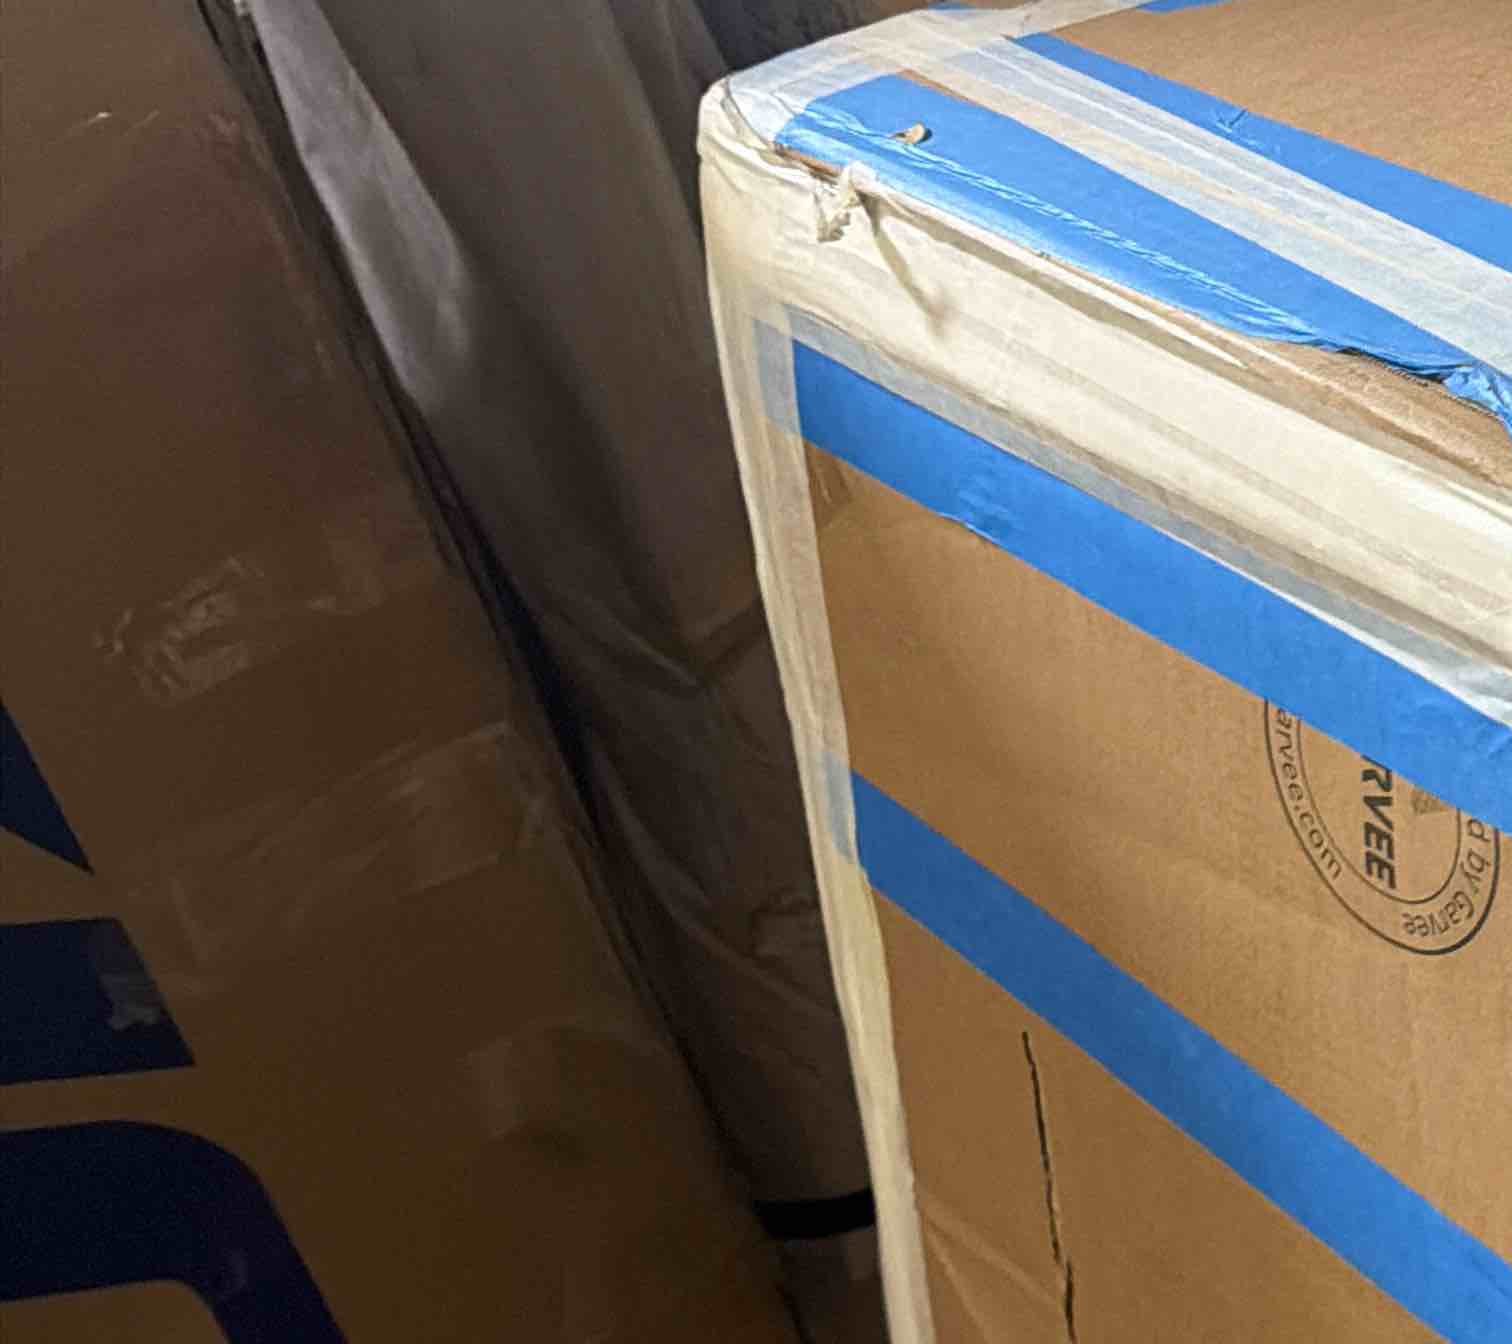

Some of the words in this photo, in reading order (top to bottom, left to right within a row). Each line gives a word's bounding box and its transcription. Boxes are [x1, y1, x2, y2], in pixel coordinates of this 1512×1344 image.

[1276, 706, 1343, 881] arvee.com
[1361, 756, 1398, 890] RVEE
[1463, 851, 1492, 894] by
